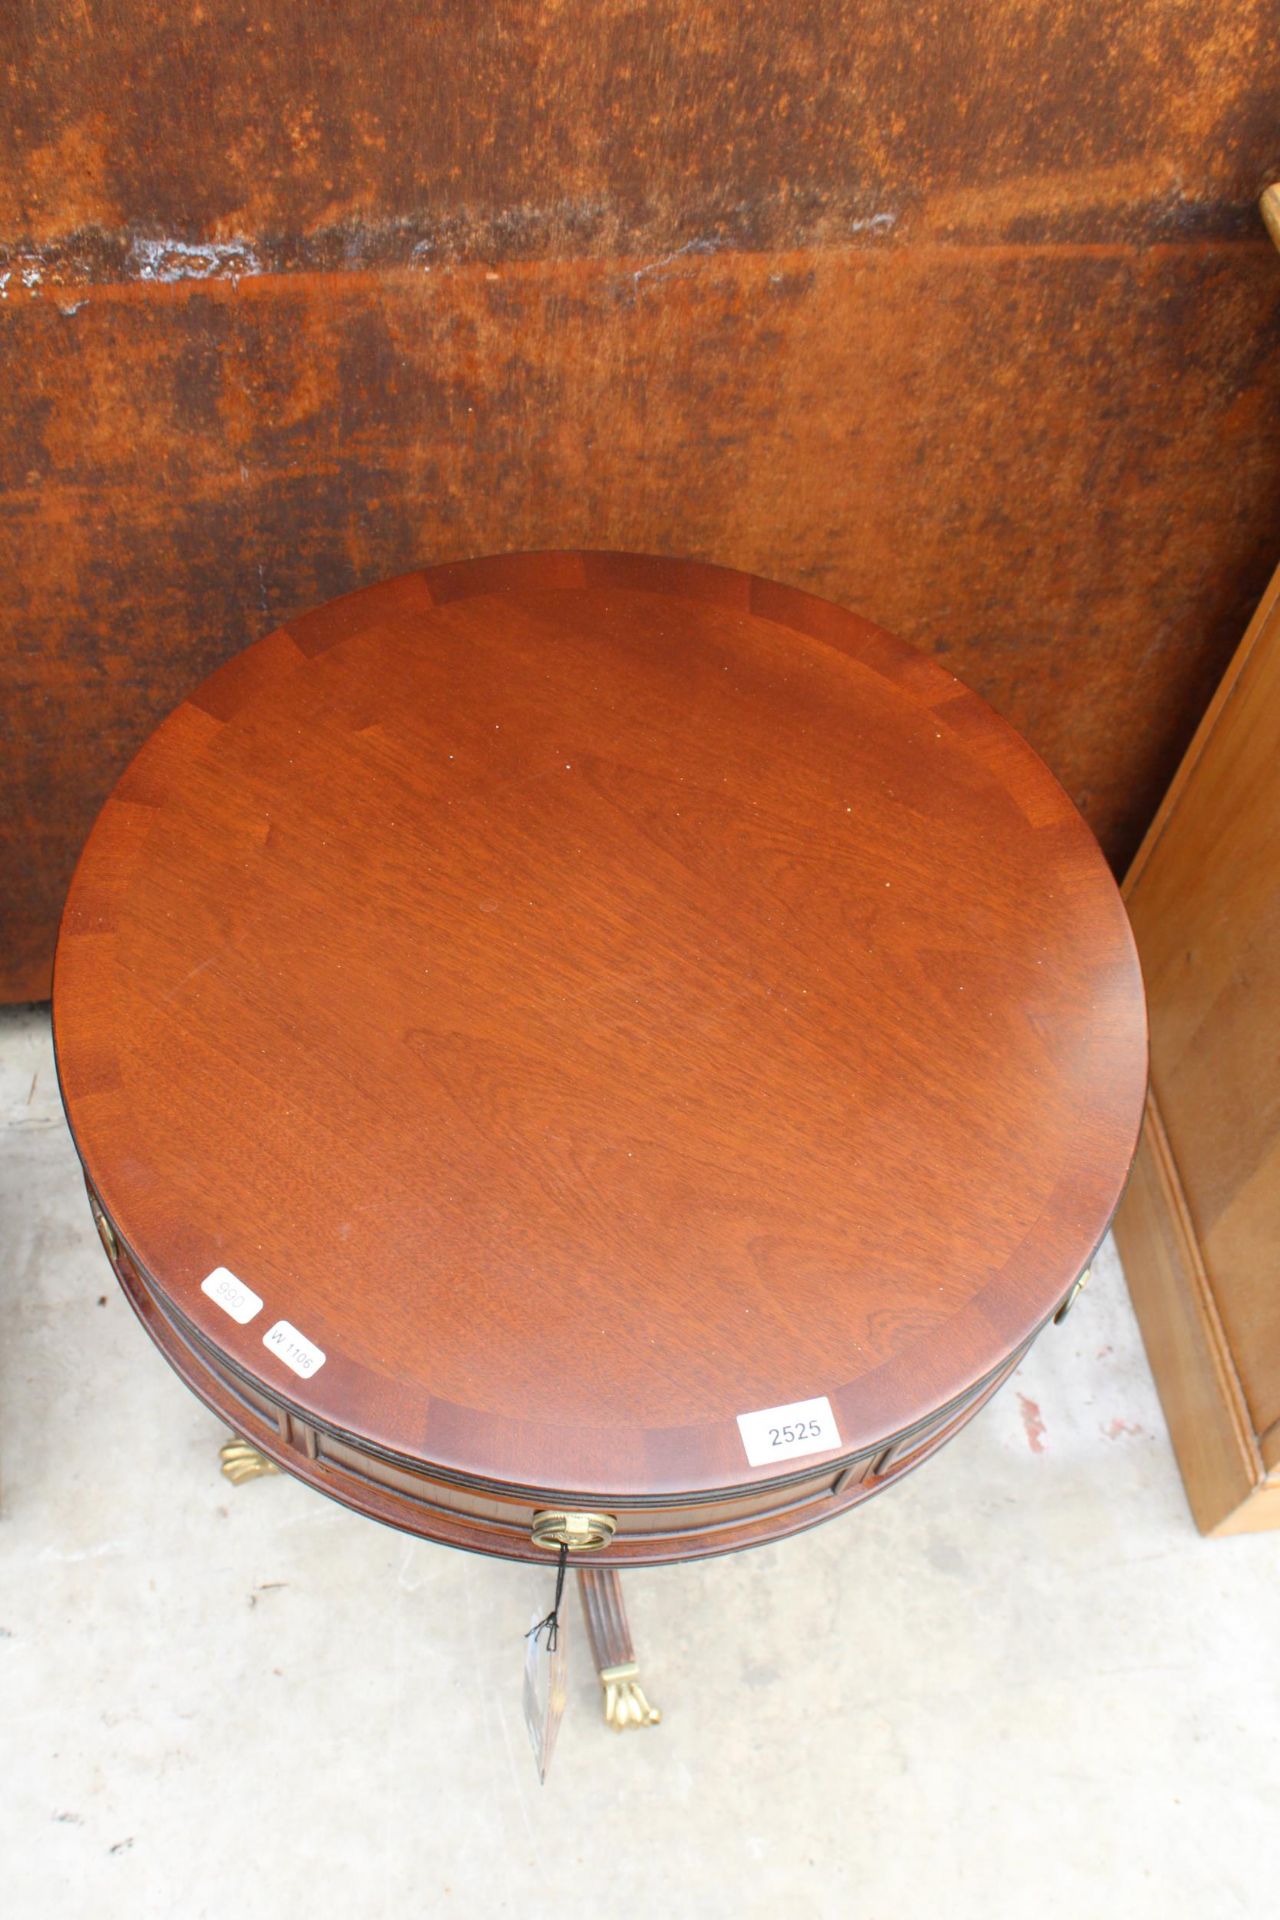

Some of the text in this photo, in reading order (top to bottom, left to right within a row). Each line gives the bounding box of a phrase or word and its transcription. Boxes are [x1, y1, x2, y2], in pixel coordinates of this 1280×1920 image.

[271, 1329, 314, 1369] W 1106
[768, 1419, 821, 1446] 2525
